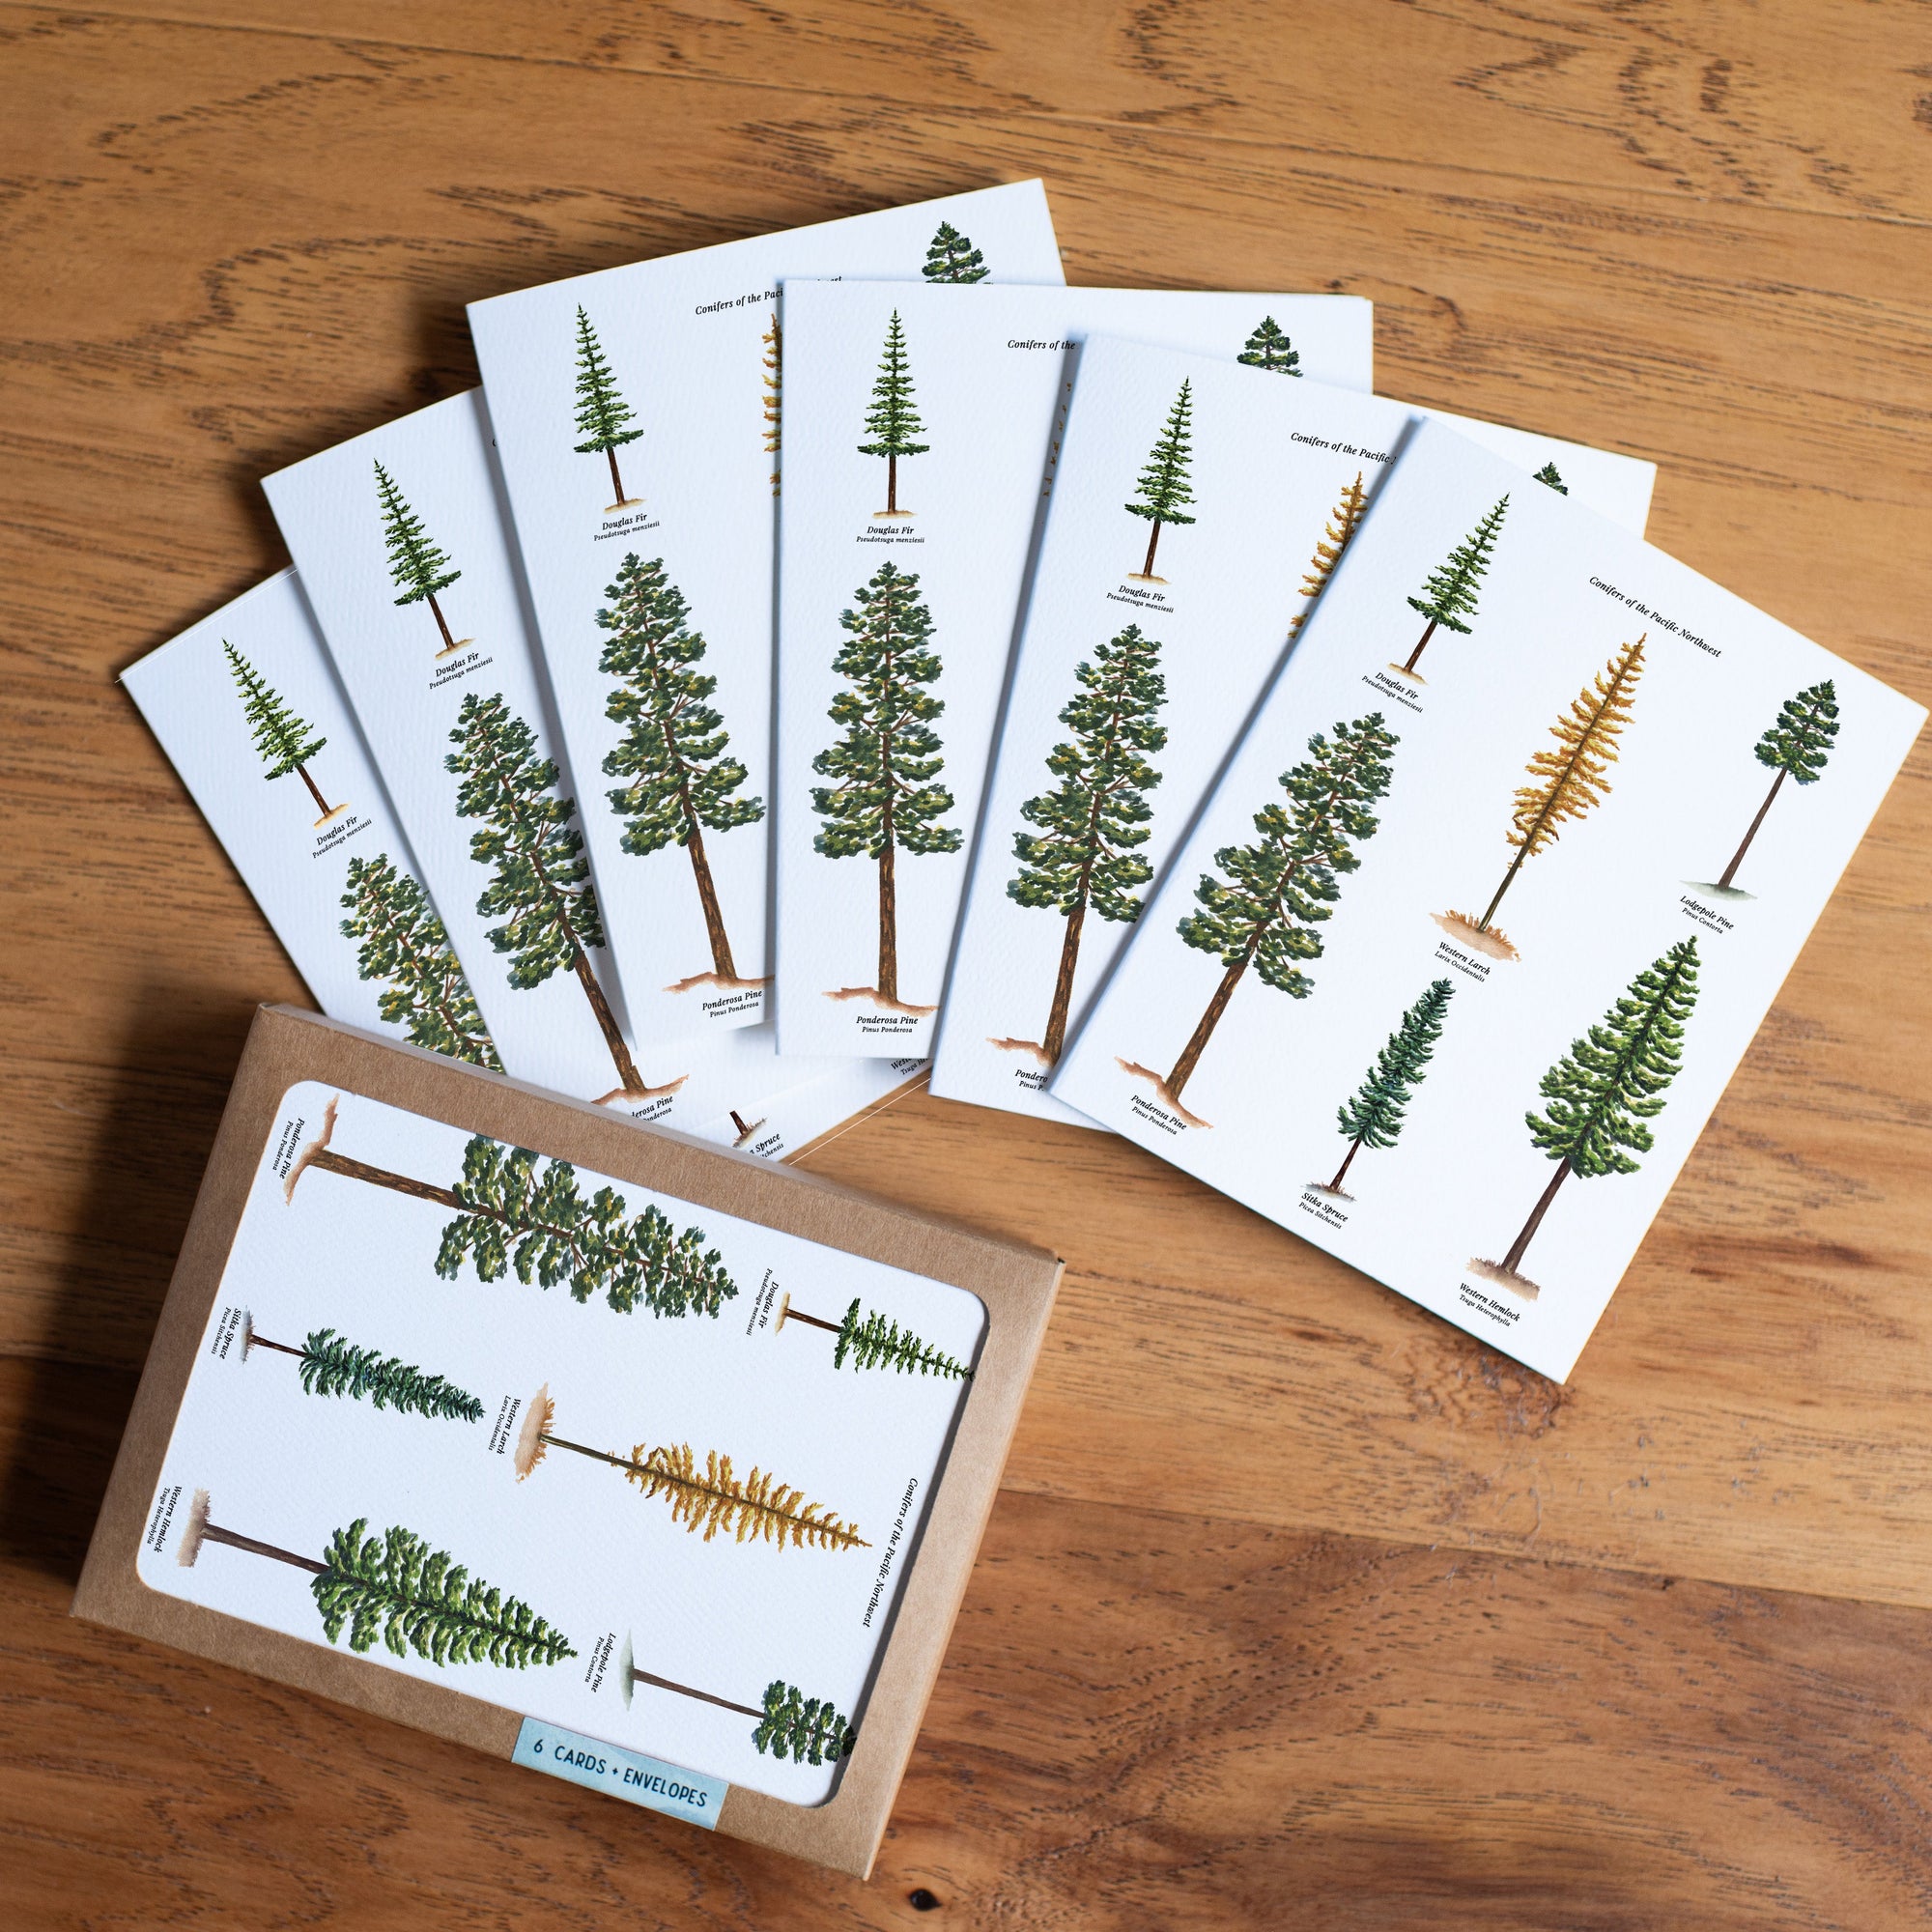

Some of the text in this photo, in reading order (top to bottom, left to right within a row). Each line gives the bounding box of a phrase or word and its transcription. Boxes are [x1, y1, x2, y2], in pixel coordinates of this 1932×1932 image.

[695, 287, 783, 315] Conifers of the Paci
[1008, 339, 1076, 351] Conifers of the
[1291, 432, 1330, 448] Conifers
[1331, 442, 1344, 453] of
[1343, 444, 1357, 455] the
[1358, 448, 1390, 464] Pacific
[593, 527, 631, 541] Pseudotsuga
[602, 513, 647, 530] Douglas Fir
[867, 526, 915, 535] Douglas Fir
[1106, 592, 1144, 607] Pseudotsuga
[1118, 584, 1166, 602] Douglas Fir
[1589, 576, 1722, 658] Conifers of the Pacific Northwest
[435, 652, 479, 677] Douglas Fir
[429, 669, 465, 690] Pseudotsuga
[1361, 675, 1396, 698] Pseudotsuga
[1375, 671, 1419, 699] Douglas Fir
[316, 815, 357, 846] Douglas Fir
[312, 836, 346, 859] Pseudotsuga
[1680, 895, 1734, 930] Lodgepole Pine
[1681, 907, 1724, 934] Pinus Contorta
[1434, 951, 1486, 982] Larix Occidentalis
[1439, 941, 1491, 976] Western Larch
[702, 990, 763, 1011] Ponderosa Pine
[709, 1002, 759, 1018] Pinus Ponderosa
[856, 1015, 919, 1025] Ponderosa Pine
[1014, 1068, 1048, 1083] Pondero
[1019, 1080, 1037, 1090] Pinus
[656, 1095, 673, 1109] Pine
[1130, 1094, 1187, 1130] Ponderosa Pine
[1131, 1105, 1178, 1135] Pinus Ponderosa
[271, 1121, 294, 1171] Pinus Ponderosa
[278, 1117, 305, 1179] Ponderosa Pine
[755, 1133, 781, 1152] Spruce
[1298, 1201, 1343, 1230] Picea Sitchensis
[1301, 1192, 1349, 1223] Sitka Spruce
[221, 1307, 232, 1324] Picea
[758, 1281, 780, 1329] Douglas Fir
[1460, 1282, 1520, 1321] Western Hemlock
[1475, 1304, 1511, 1327] Heterophylla
[218, 1308, 242, 1360] Sitka Spruce
[488, 1395, 511, 1451] Larix Occidentalis
[497, 1398, 522, 1455] Western Larch
[147, 1505, 164, 1545] Heterophylla
[154, 1486, 183, 1553] Western Hemlock
[863, 1477, 919, 1628] Conifers of the Pacific Northwest
[584, 1636, 605, 1683] Pinus Contorta
[590, 1633, 616, 1693] Lodgepole Pine
[533, 1738, 544, 1753] 6
[554, 1745, 607, 1775] CARDS
[623, 1767, 708, 1808] ENVELOPES
